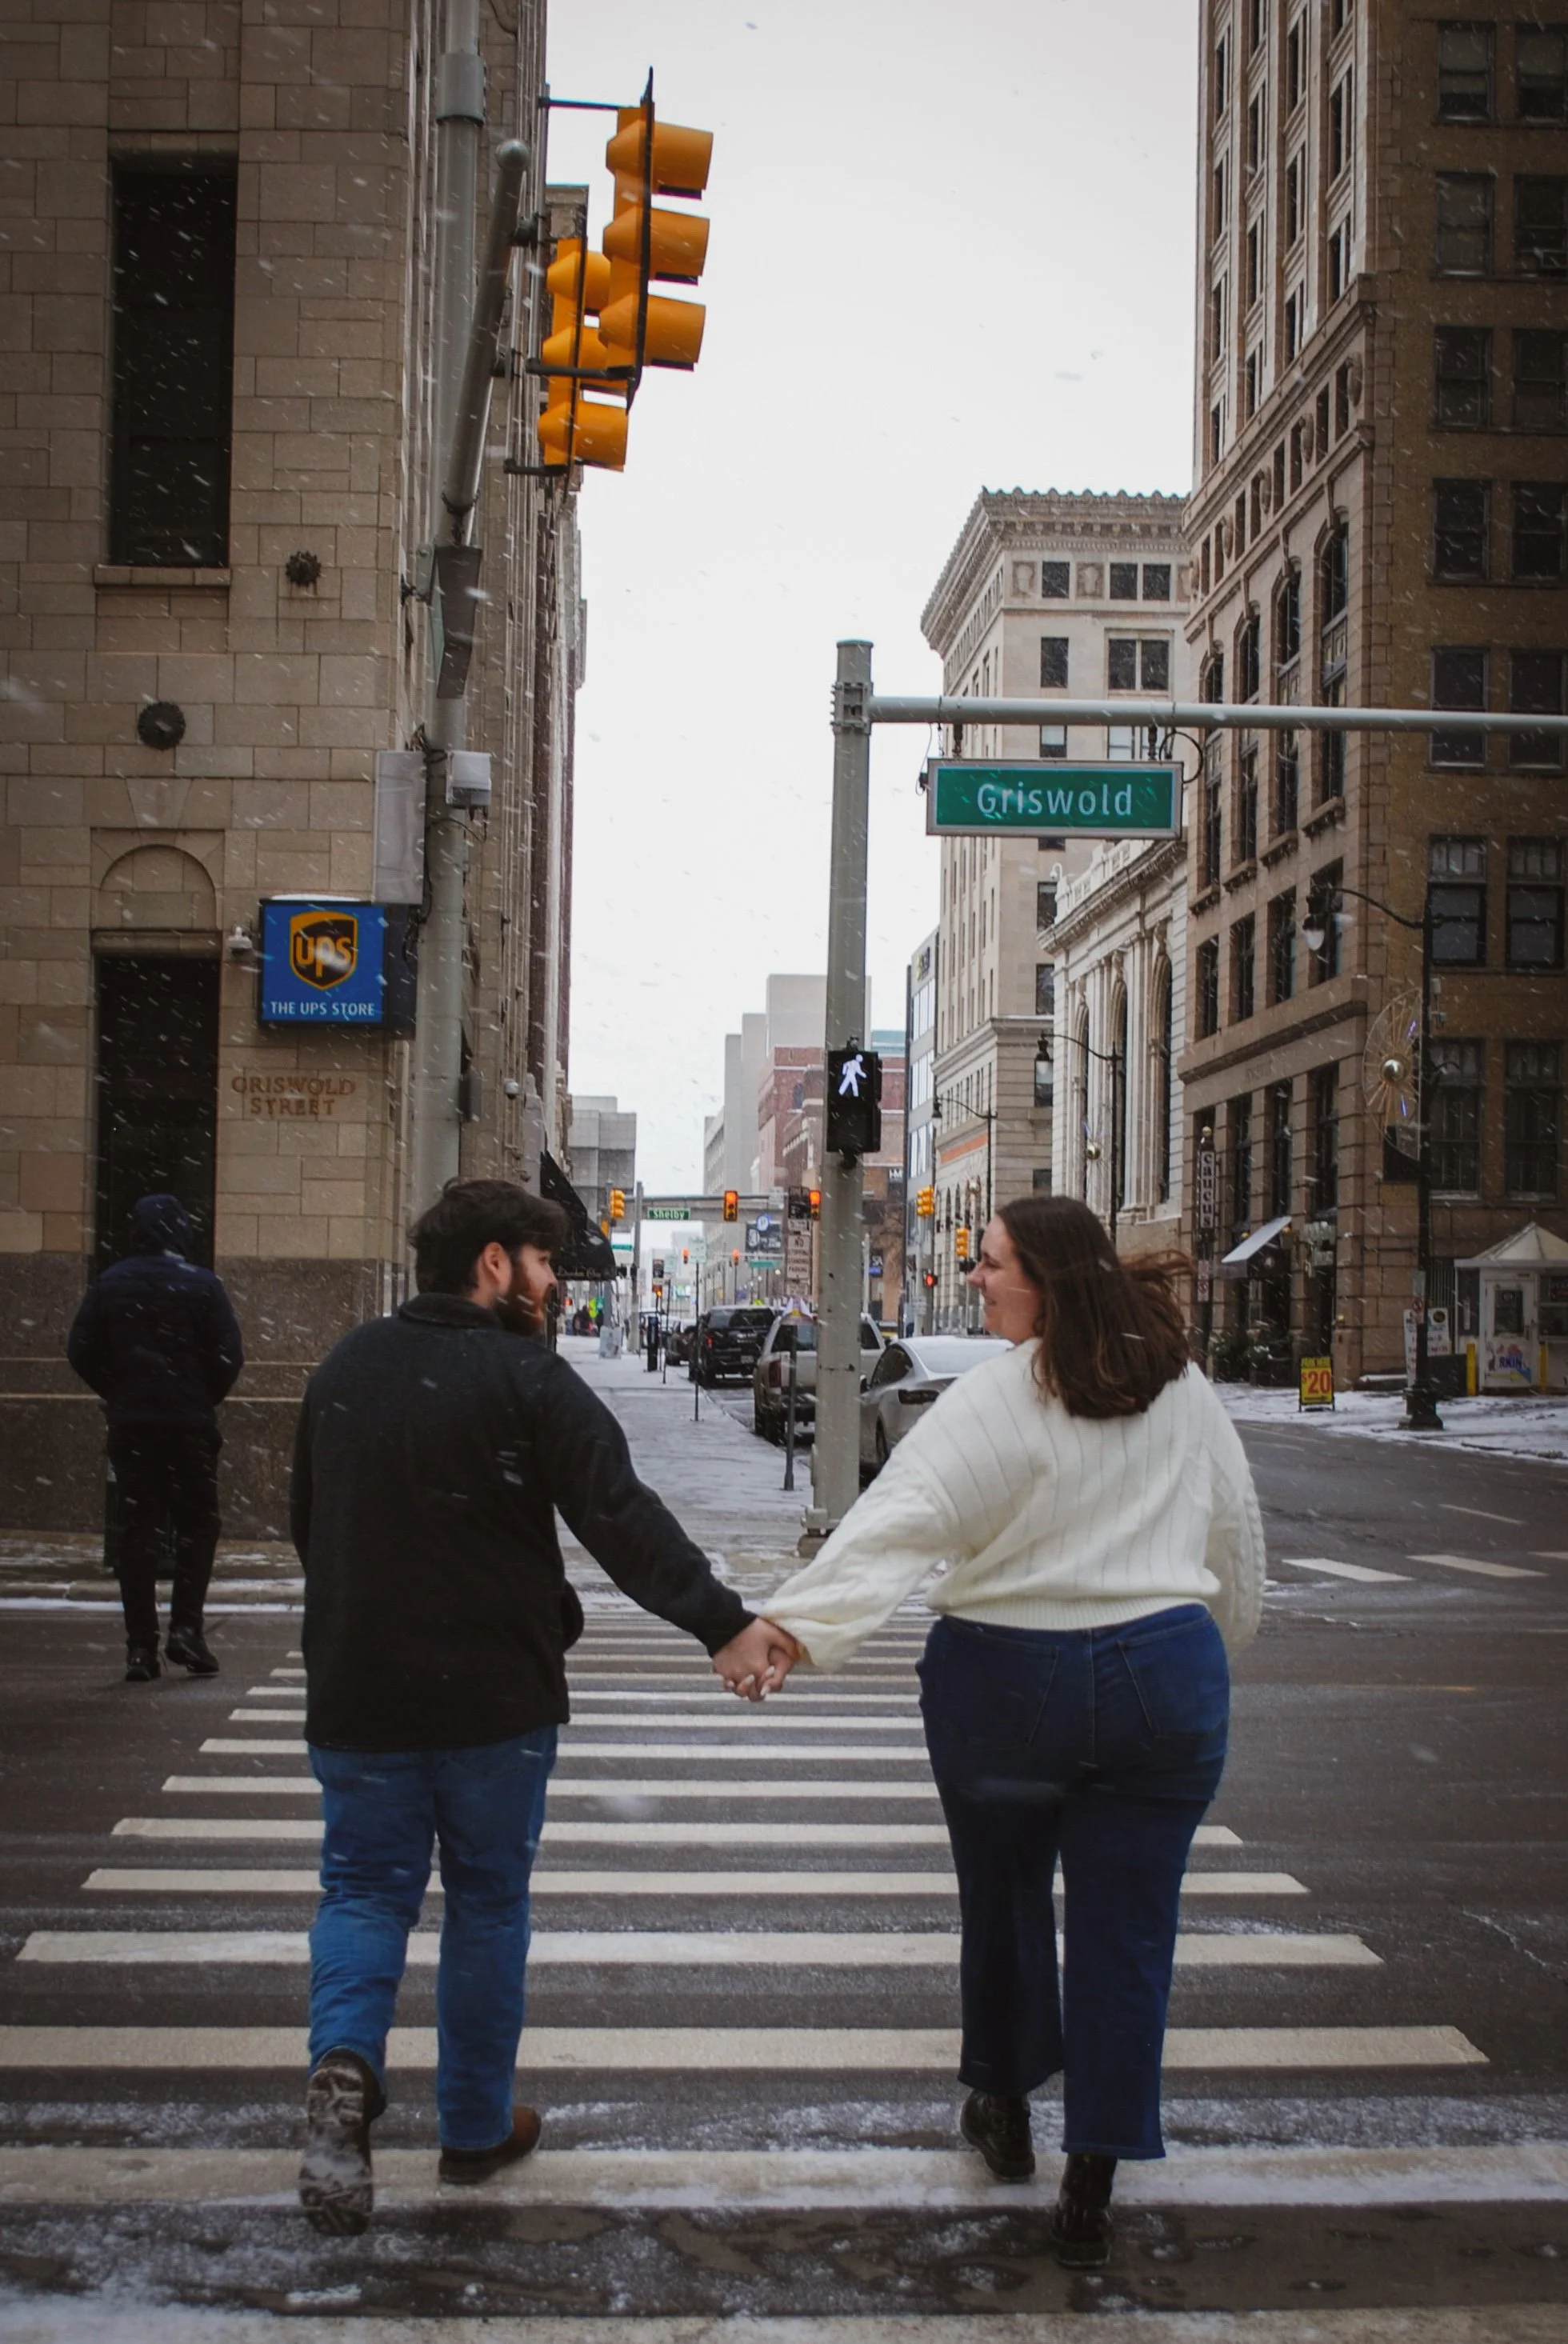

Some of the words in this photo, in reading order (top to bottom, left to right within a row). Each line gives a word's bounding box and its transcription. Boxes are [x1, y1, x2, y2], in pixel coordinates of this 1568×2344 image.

[977, 781, 1133, 816] Griswold
[270, 1002, 295, 1014] THE
[300, 1002, 327, 1015] UPS
[332, 1002, 375, 1016] STORE
[250, 1098, 335, 1115] STREET
[653, 1209, 685, 1219] Shelby
[794, 1238, 804, 1248] NO
